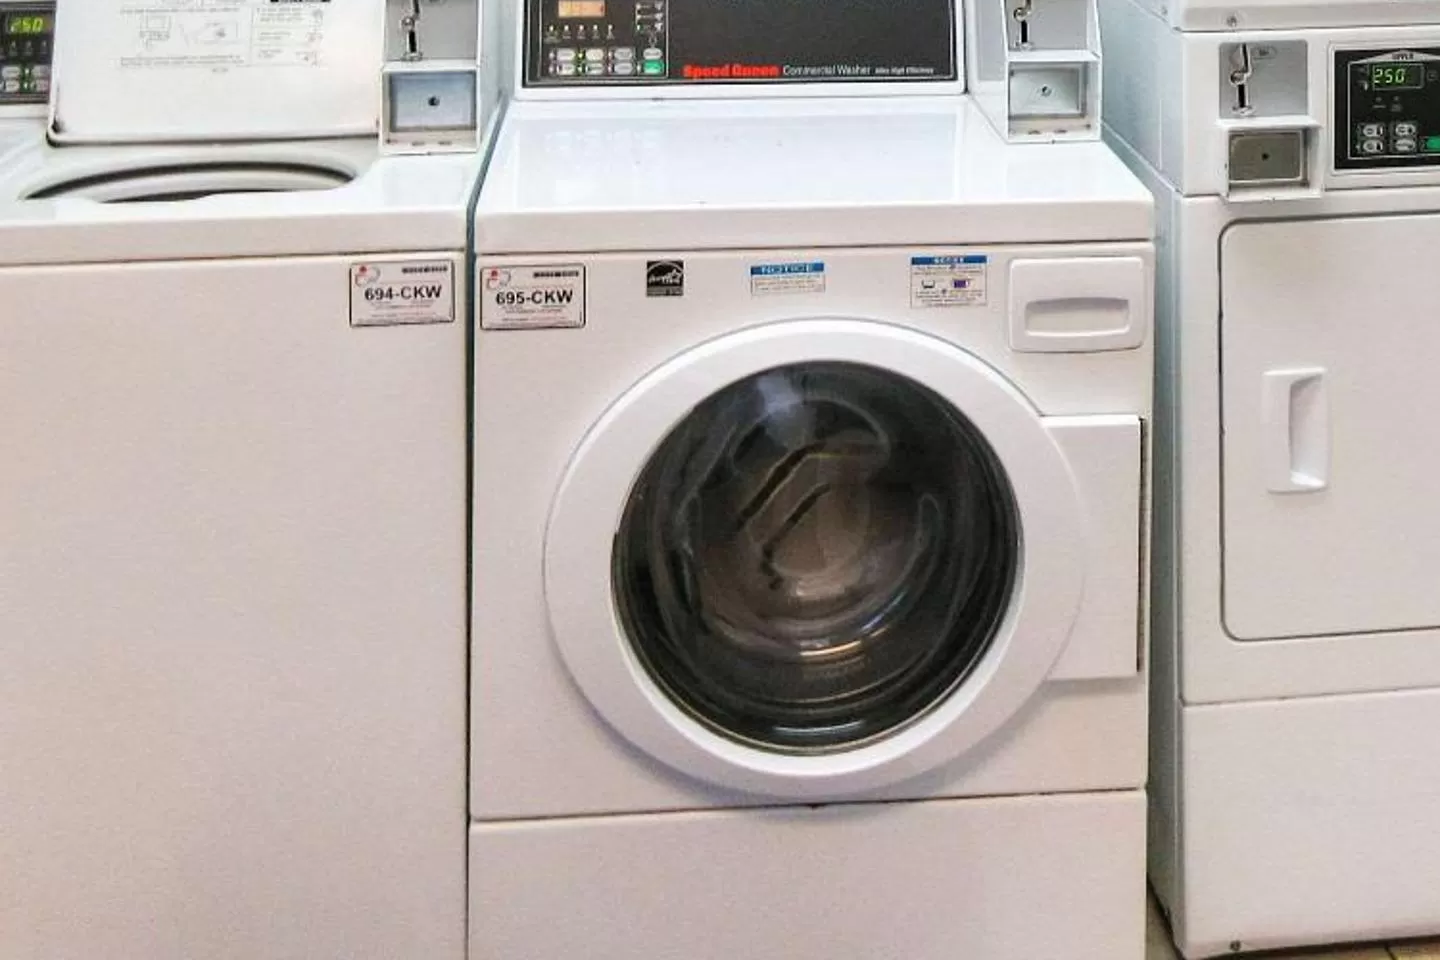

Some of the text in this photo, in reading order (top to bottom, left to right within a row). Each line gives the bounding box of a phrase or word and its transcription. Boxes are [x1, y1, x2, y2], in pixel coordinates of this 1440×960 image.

[683, 63, 730, 79] Speed
[731, 63, 779, 77] Queen
[782, 64, 836, 76] Commercial
[837, 64, 870, 76] Washer
[1374, 68, 1406, 84] 250
[364, 284, 442, 300] 694-CKW
[496, 289, 573, 305] 695-CKW
